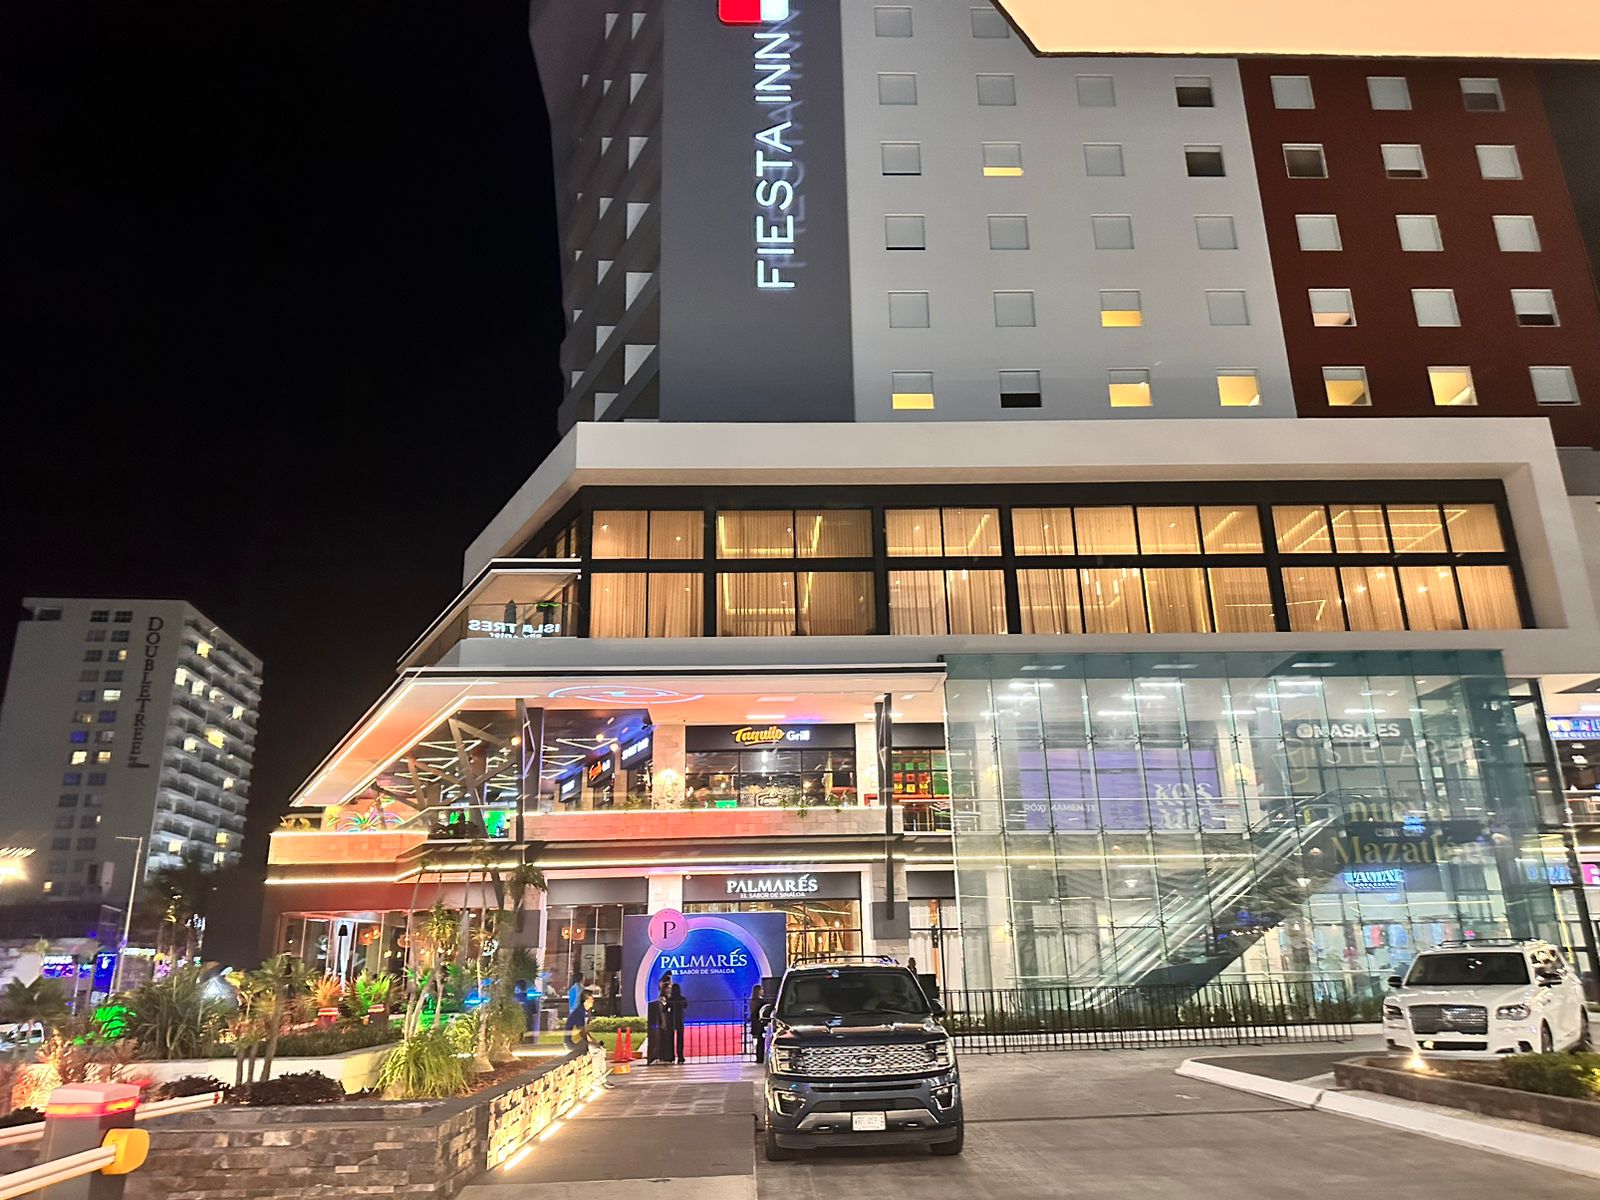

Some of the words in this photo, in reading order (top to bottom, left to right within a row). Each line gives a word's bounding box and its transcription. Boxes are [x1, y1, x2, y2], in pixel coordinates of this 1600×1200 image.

[753, 33, 792, 102] INN
[756, 121, 796, 289] FIESTA
[131, 616, 164, 756] DOUBLETREE
[786, 730, 810, 741] Grill
[1313, 722, 1400, 738] MASAES
[726, 874, 818, 893] PALMARÉS
[663, 921, 676, 939] P
[660, 948, 748, 968] PALMARÉS
